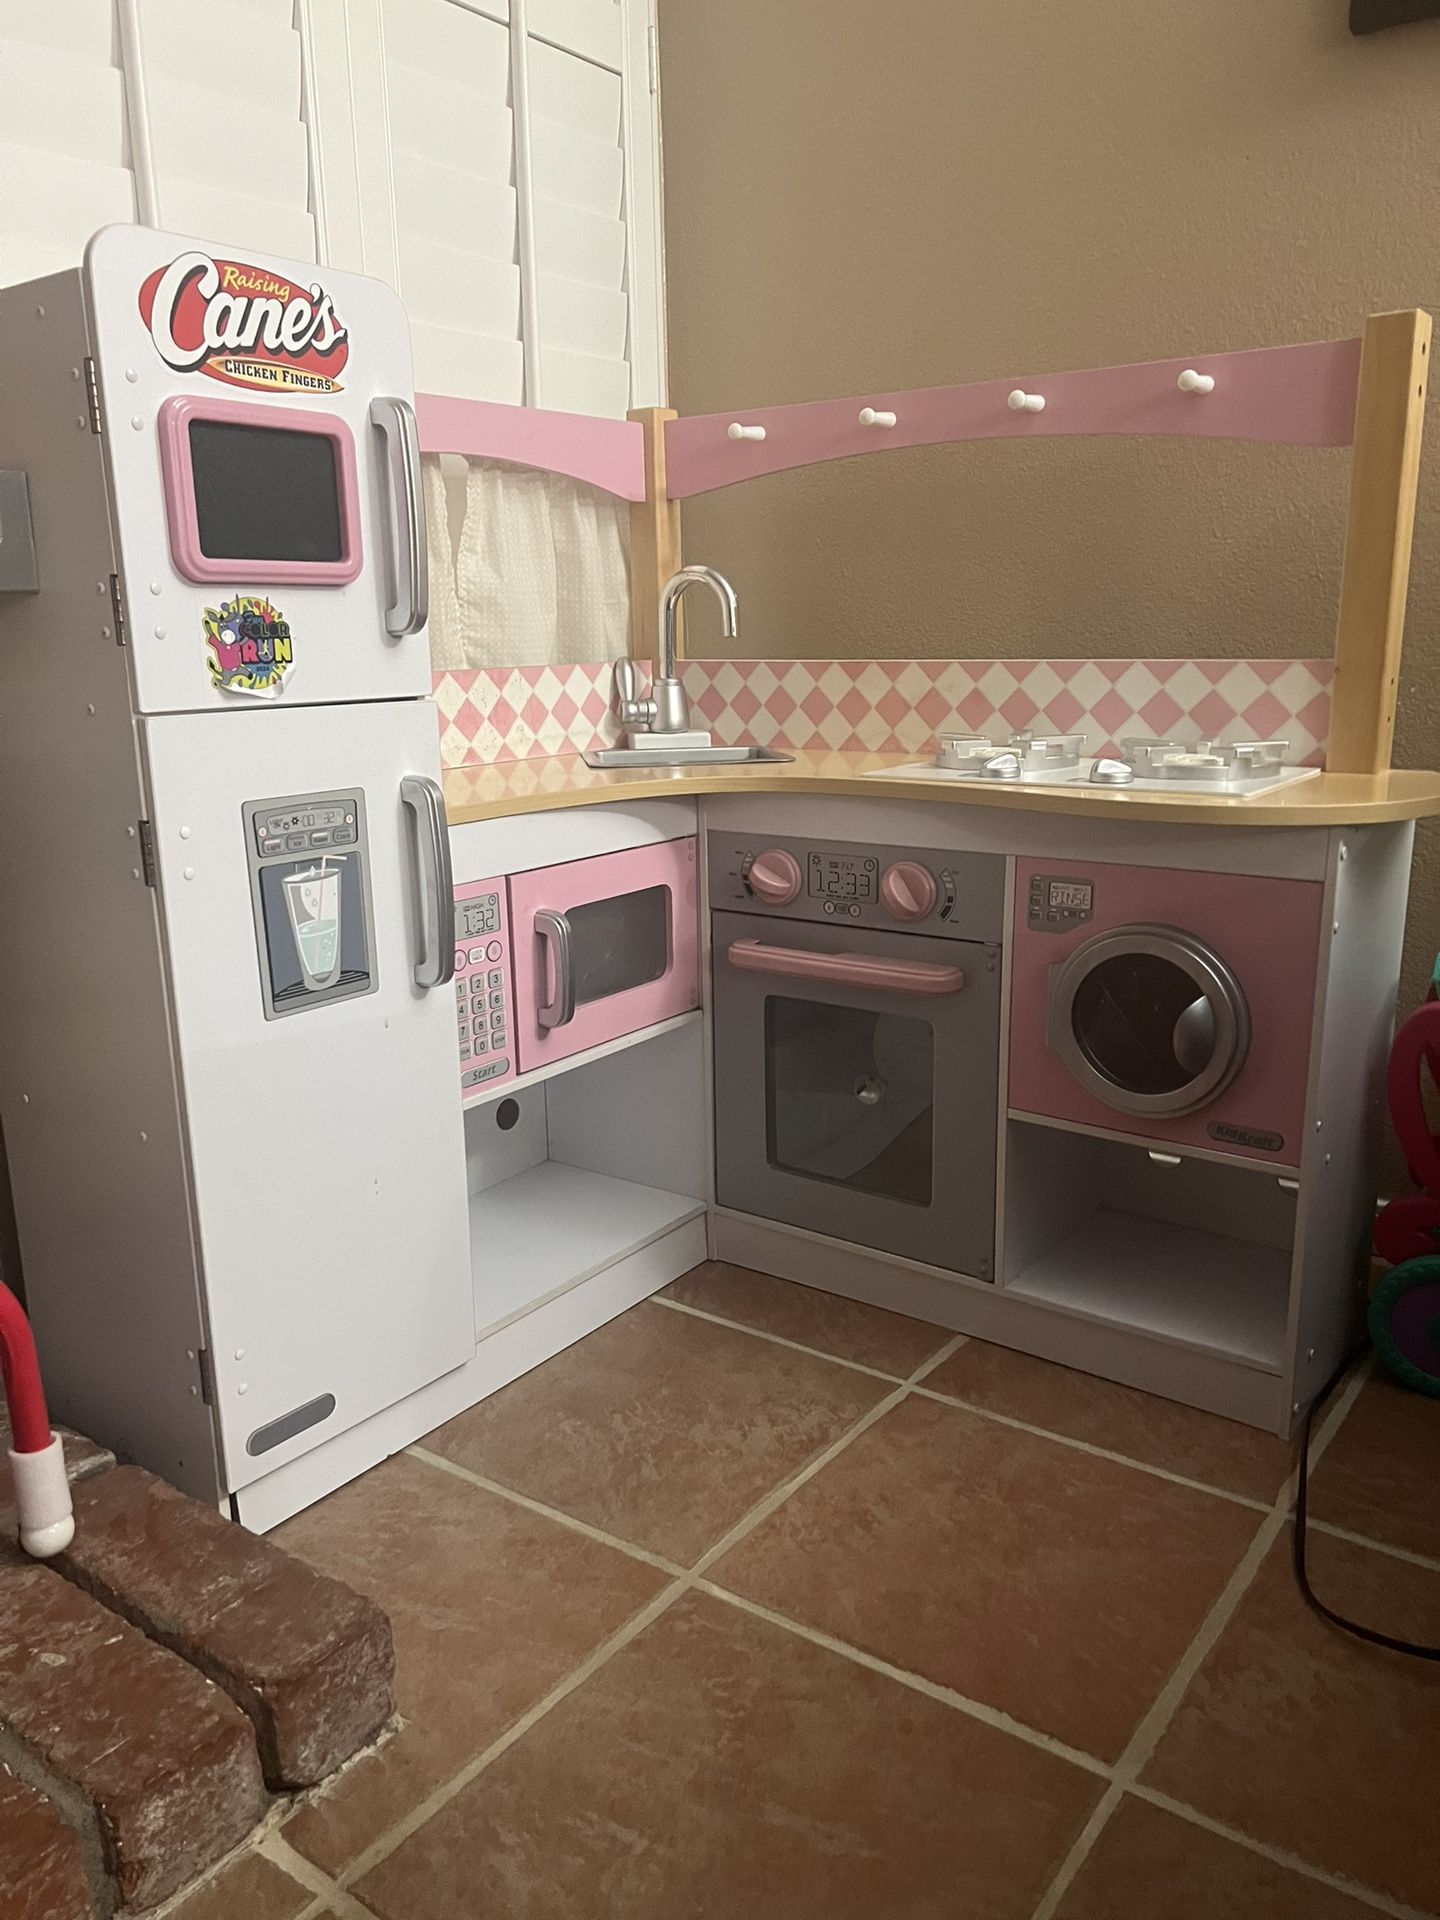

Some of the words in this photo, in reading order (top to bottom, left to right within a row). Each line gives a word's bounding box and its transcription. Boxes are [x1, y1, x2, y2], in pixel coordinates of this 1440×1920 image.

[222, 265, 291, 303] Raising
[151, 251, 348, 373] Cane's
[224, 359, 278, 382] CHICKEN
[282, 370, 331, 391] FINGERS
[241, 637, 292, 664] RUN
[816, 869, 870, 897] 12:33
[1051, 890, 1090, 906] RINSE
[463, 908, 495, 934] 1:32
[472, 1065, 497, 1081] Start
